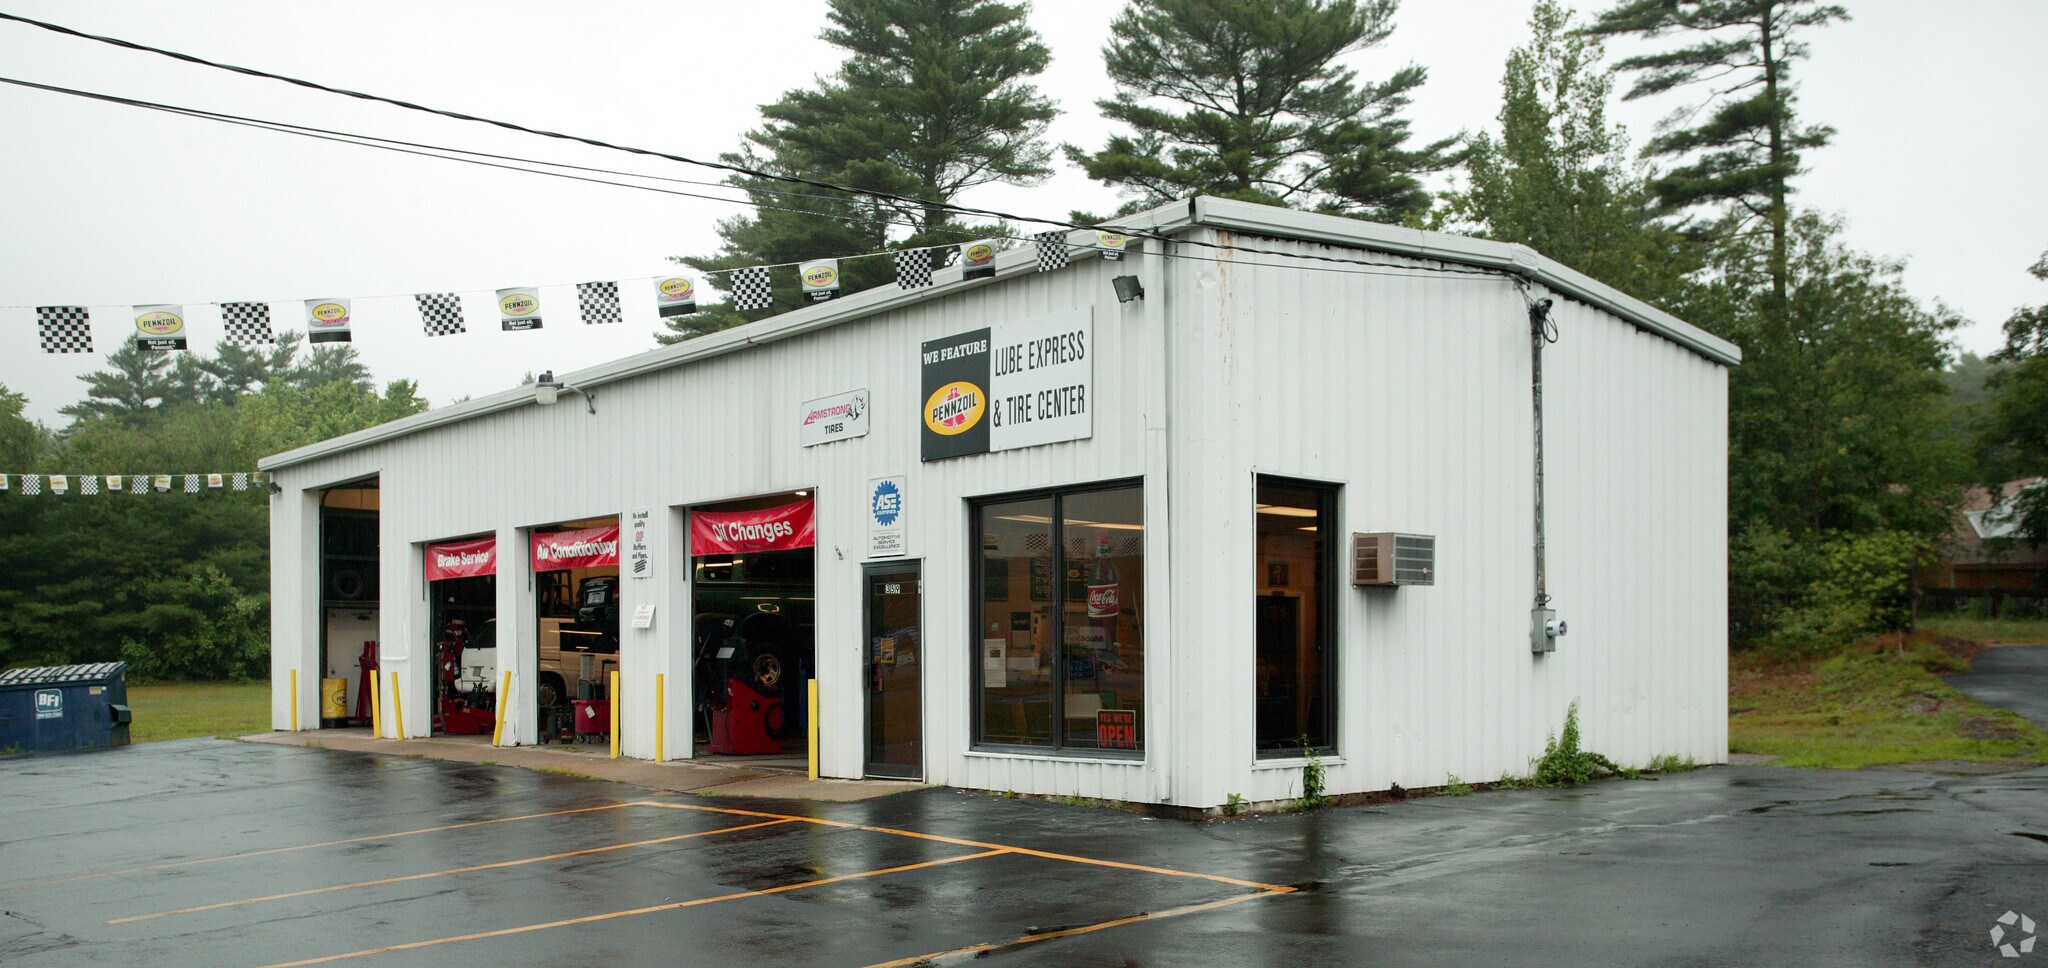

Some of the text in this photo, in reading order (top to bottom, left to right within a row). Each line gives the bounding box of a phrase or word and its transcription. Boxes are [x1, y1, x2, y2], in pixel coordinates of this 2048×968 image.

[807, 271, 832, 281] PENNZOIL
[664, 282, 686, 291] PENNZOIL
[317, 307, 342, 316] PENNZOIL
[504, 299, 533, 310] PENNZOIL
[143, 318, 177, 328] PENNZOIL
[923, 340, 988, 366] WE FEATURE
[995, 330, 1085, 377] LUBE EXPRESS
[803, 404, 852, 426] ARMSTRONG
[932, 392, 977, 423] PENNZOIL
[993, 384, 1085, 428] & TIRE CENTER
[824, 423, 844, 435] TIRES
[875, 493, 897, 511] ASE
[711, 520, 794, 543] Oil Changes
[537, 538, 617, 560] Air Conditioning
[437, 549, 489, 568] Brake Service
[38, 693, 59, 707] BFI
[1100, 713, 1111, 722] YES
[1098, 724, 1136, 748] OPEN
